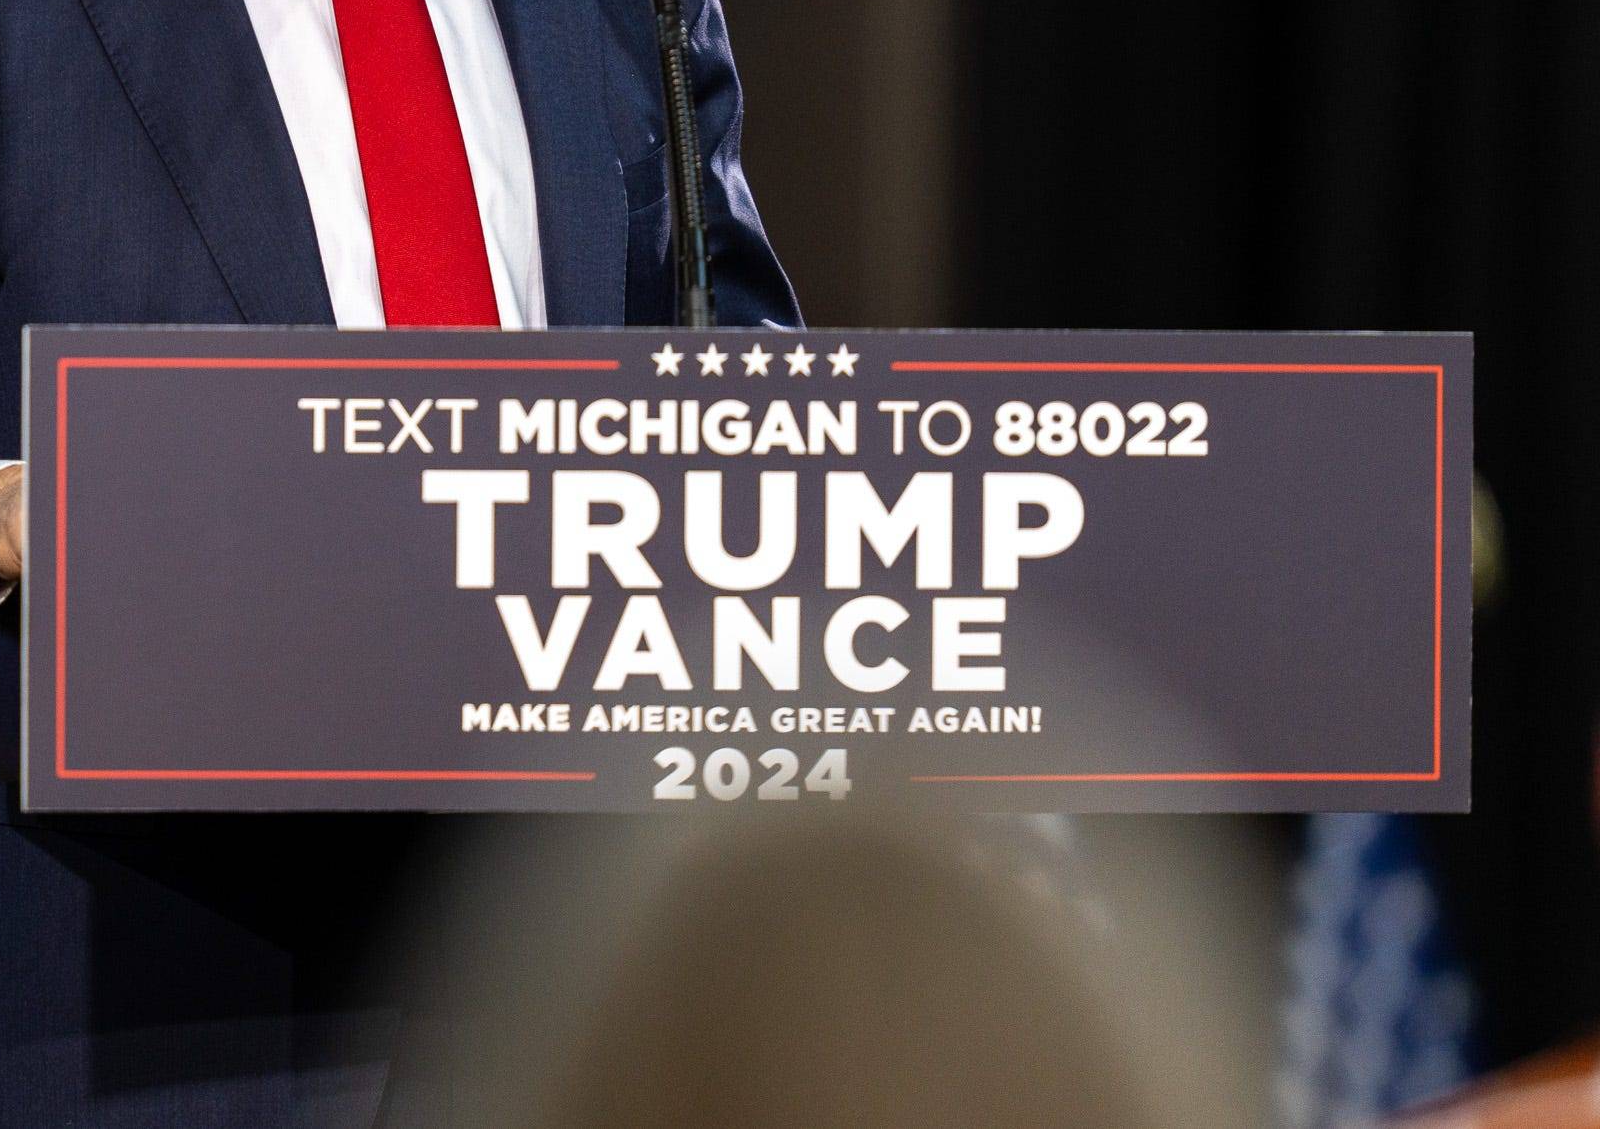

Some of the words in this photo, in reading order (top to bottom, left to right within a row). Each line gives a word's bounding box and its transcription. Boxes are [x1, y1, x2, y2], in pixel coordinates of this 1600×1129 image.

[298, 398, 479, 454] TEXT
[499, 398, 857, 456] MICHIGAN
[878, 400, 972, 456] TO
[993, 400, 1209, 457] 88022
[421, 469, 1085, 591] TRUMP
[495, 594, 1007, 693] VANCE
[461, 703, 571, 733] MAKE
[581, 703, 758, 734] AMERICA
[770, 706, 896, 734] GREAT
[907, 705, 1042, 734] AGAIN!
[651, 746, 853, 802] 2024
